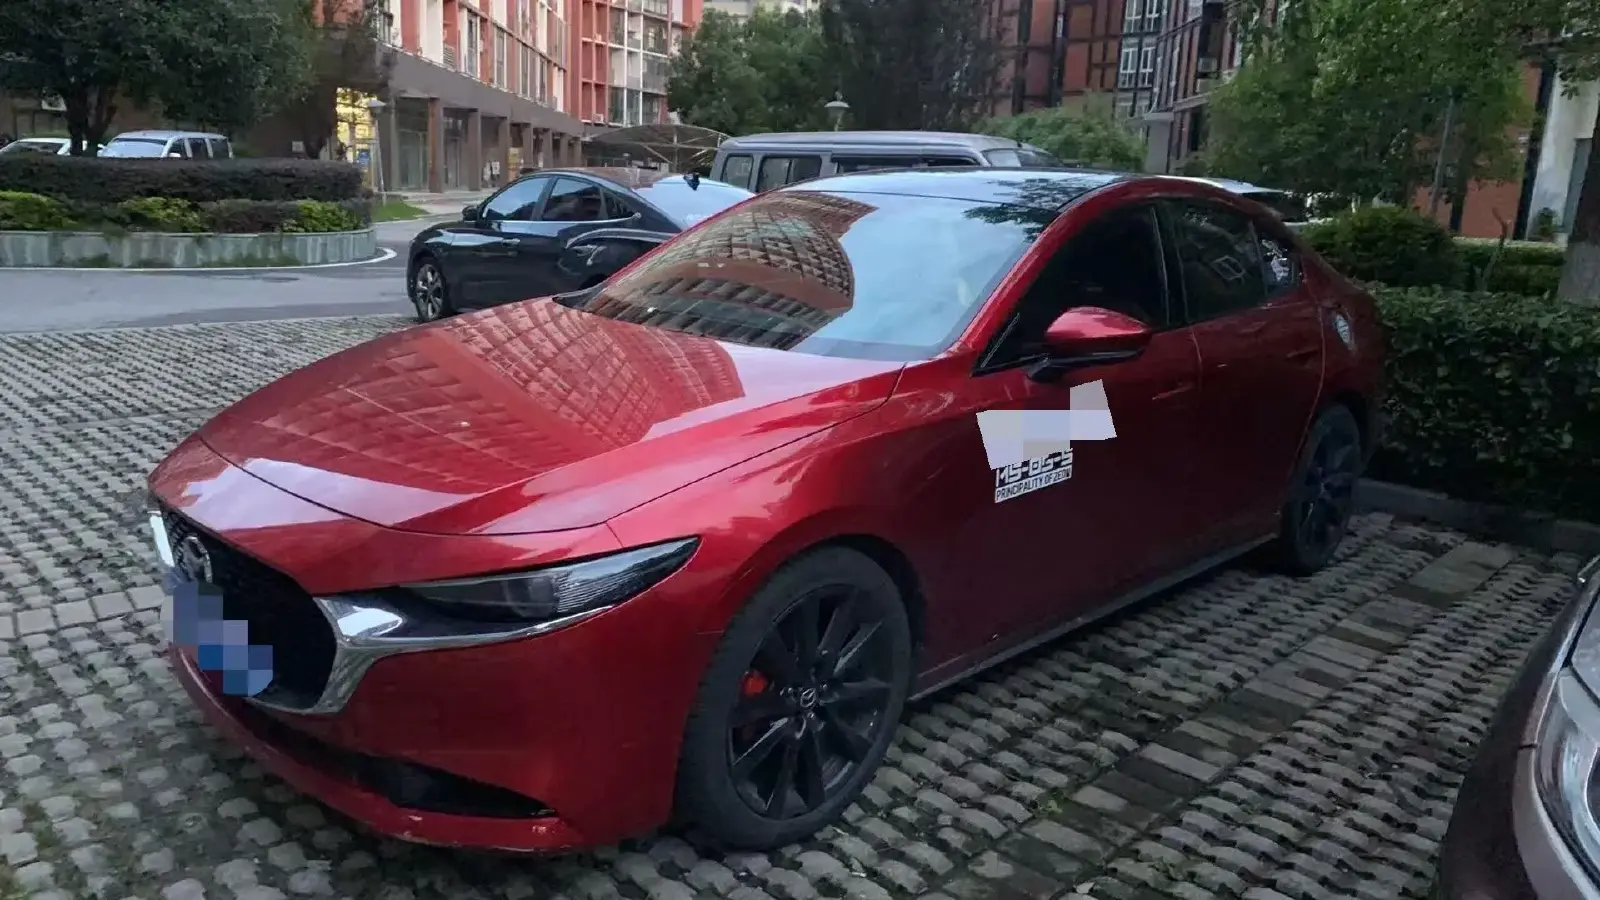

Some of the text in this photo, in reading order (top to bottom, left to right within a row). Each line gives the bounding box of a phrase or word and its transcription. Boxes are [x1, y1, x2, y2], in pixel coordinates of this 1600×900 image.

[996, 467, 1071, 501] PRINCIPALITY OF ZEON
